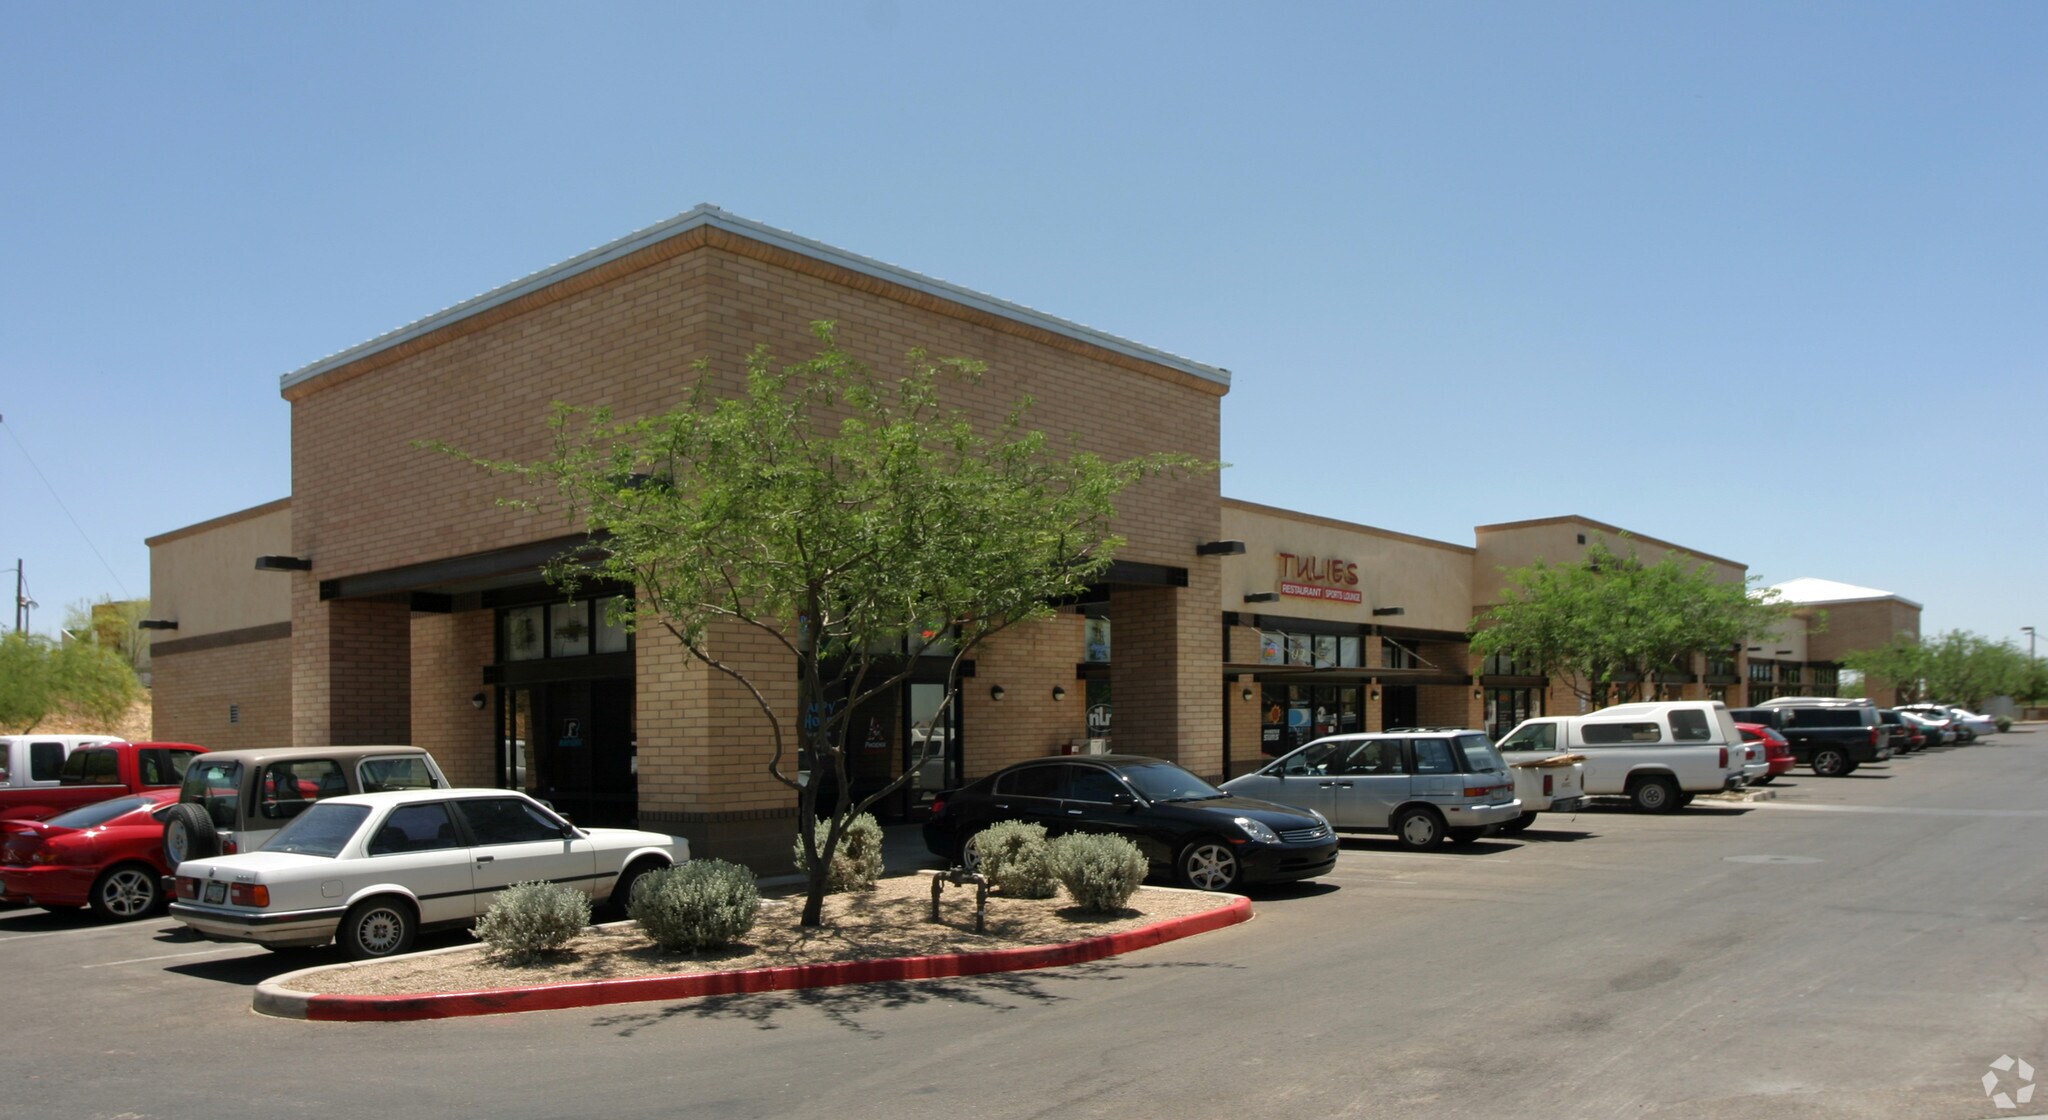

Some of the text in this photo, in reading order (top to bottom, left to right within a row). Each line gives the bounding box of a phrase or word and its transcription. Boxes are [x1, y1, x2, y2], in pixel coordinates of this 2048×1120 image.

[1279, 552, 1359, 585] TULIES
[1282, 585, 1361, 602] RESTAURANT SPORTS LOUNGE
